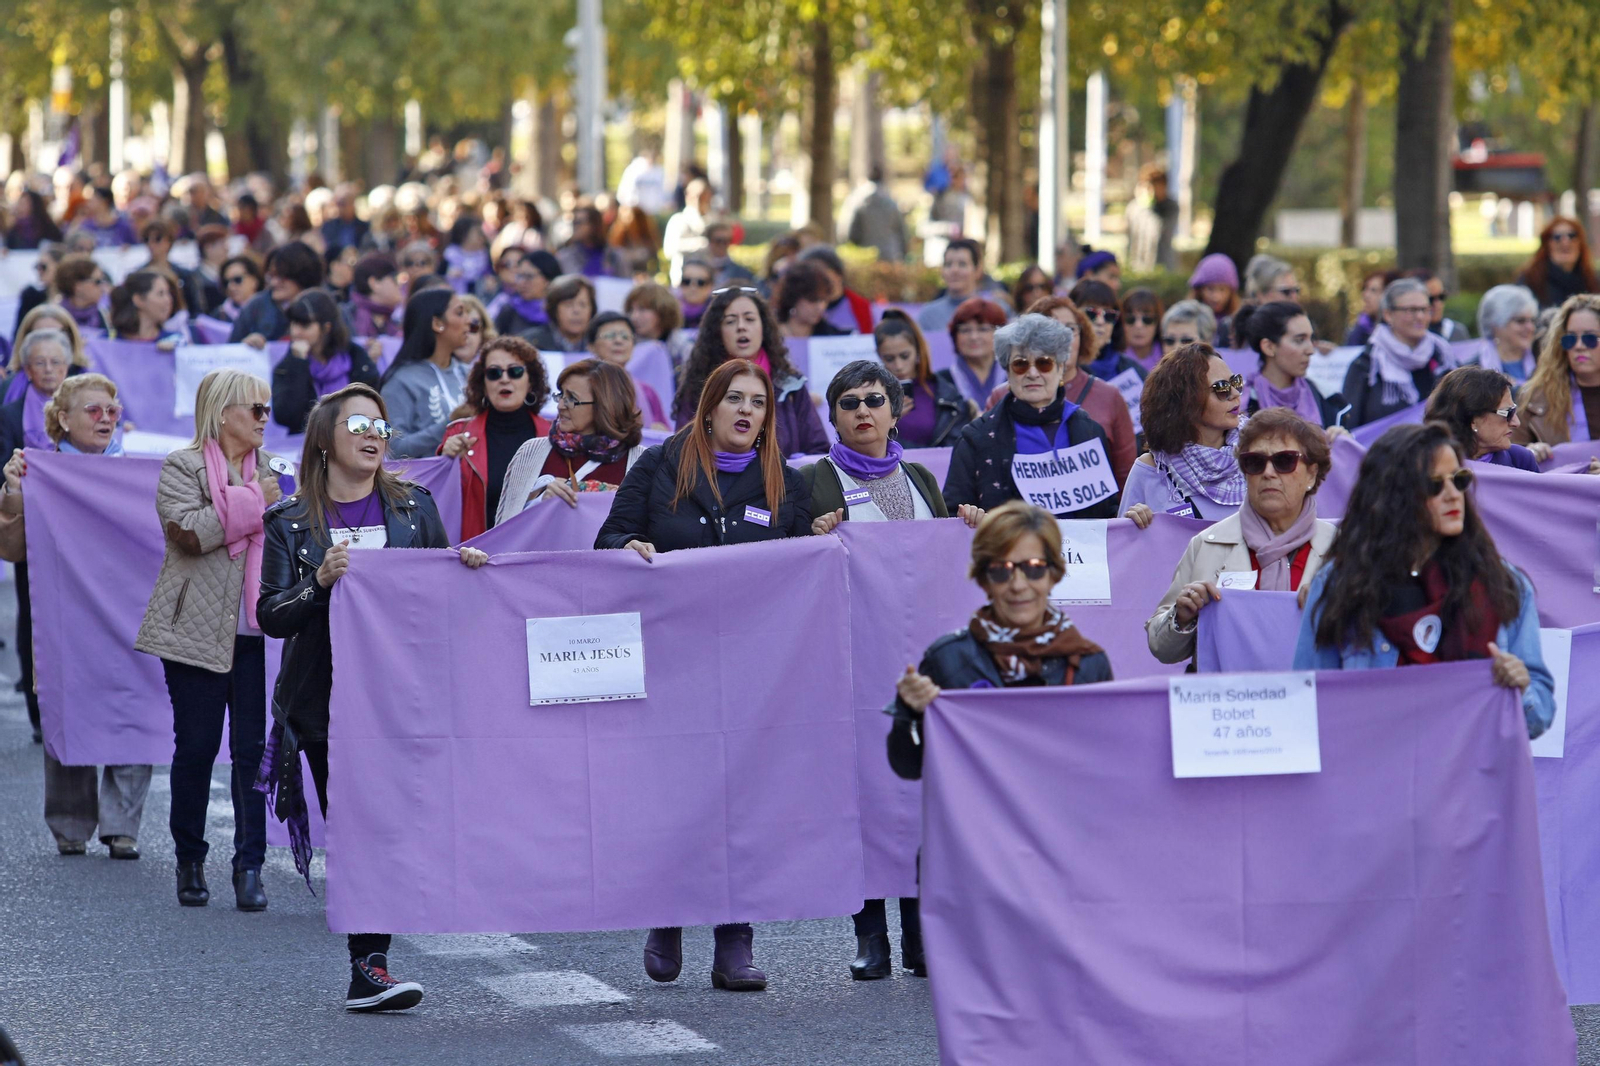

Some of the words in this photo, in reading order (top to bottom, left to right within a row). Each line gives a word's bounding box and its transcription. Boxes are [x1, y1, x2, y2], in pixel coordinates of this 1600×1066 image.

[1014, 456, 1079, 479] HERMANA
[1078, 448, 1100, 469] NO
[844, 491, 870, 501] CCOO
[1029, 487, 1072, 510] ESTÁS
[1073, 480, 1110, 504] SOLA
[745, 510, 770, 522] CCOO
[576, 637, 601, 645] MARZO
[540, 650, 587, 663] MARIA
[590, 645, 632, 661] JESÚS
[581, 665, 600, 674] AÑOS
[1226, 687, 1287, 703] Soledad
[1212, 708, 1256, 722] Bobet
[1213, 726, 1231, 739] 47
[1236, 725, 1273, 739] años
